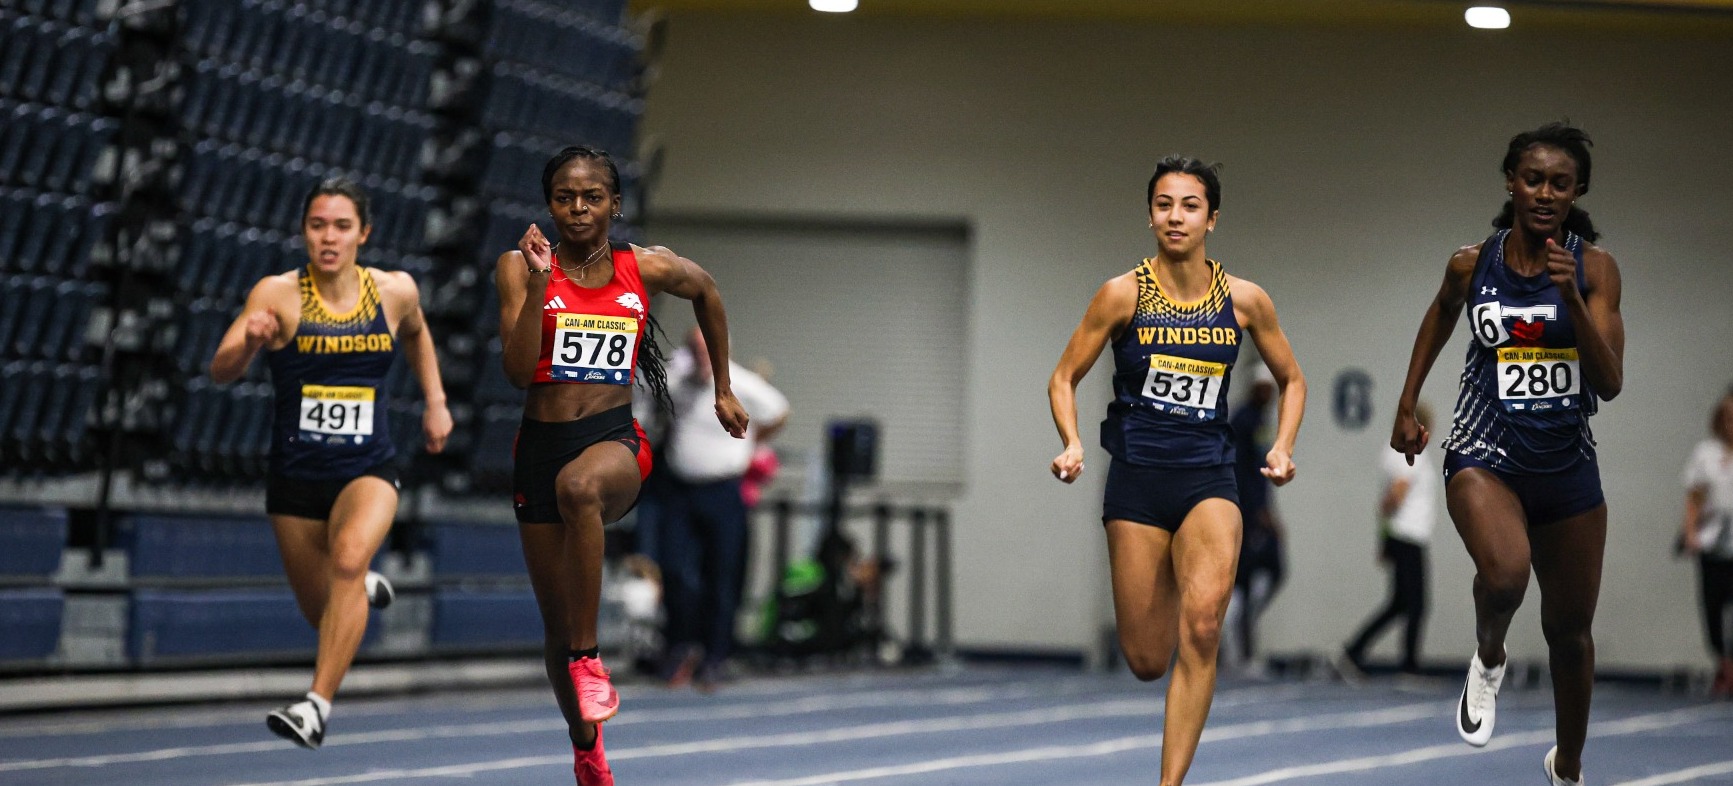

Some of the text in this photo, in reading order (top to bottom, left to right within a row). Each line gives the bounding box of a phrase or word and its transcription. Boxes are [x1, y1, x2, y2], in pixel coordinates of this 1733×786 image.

[565, 318, 626, 331] CAN-AM CLASSIC
[1137, 327, 1237, 346] WINDSOR
[1477, 305, 1500, 344] 6
[296, 333, 393, 354] WINDSOR
[560, 331, 628, 367] 578
[1504, 351, 1565, 360] CAN-AM CLASSIC
[1158, 359, 1215, 375] CAN-AM CLASSIC
[1150, 371, 1210, 405] 531
[1505, 362, 1572, 397] 280
[307, 402, 361, 430] 491
